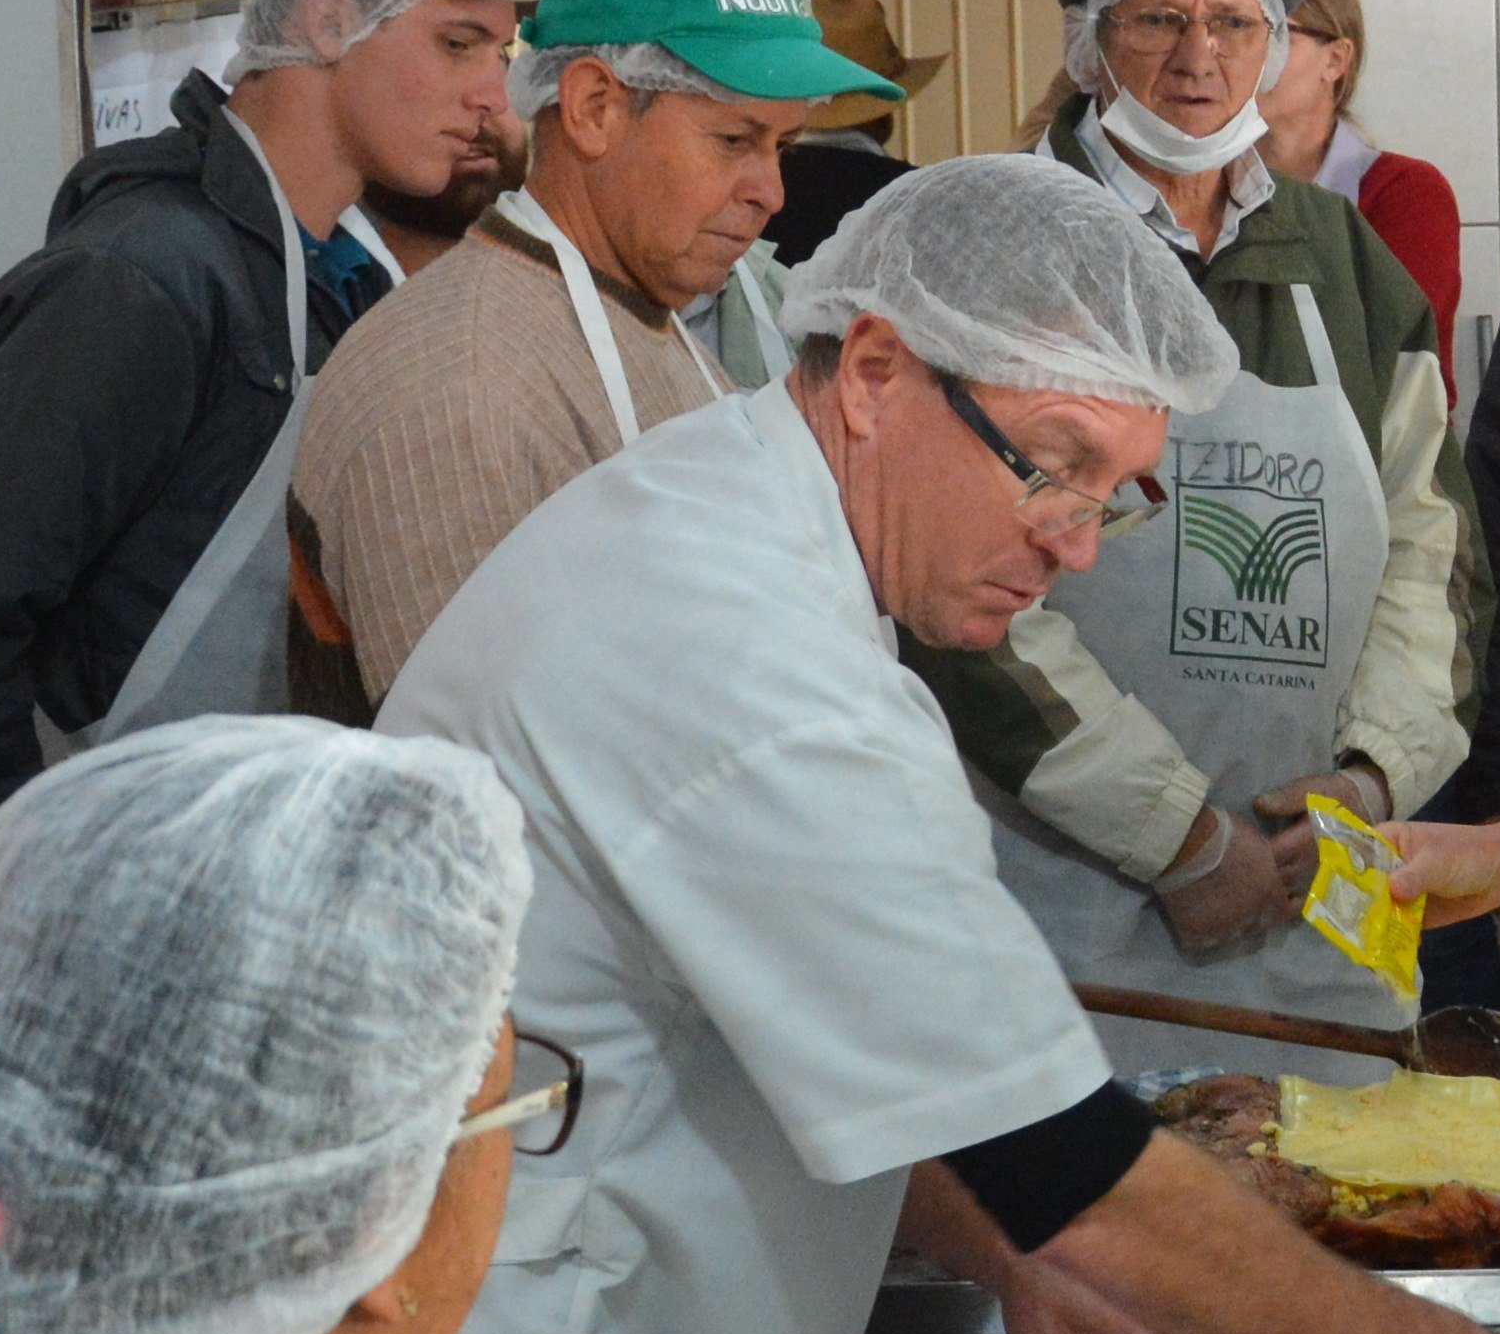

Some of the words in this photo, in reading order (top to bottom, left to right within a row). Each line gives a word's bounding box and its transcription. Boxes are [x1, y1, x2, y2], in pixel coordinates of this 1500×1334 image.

[1180, 605, 1322, 653] SENAR
[1182, 667, 1240, 685] SANTA
[1244, 670, 1316, 691] CATARINA
